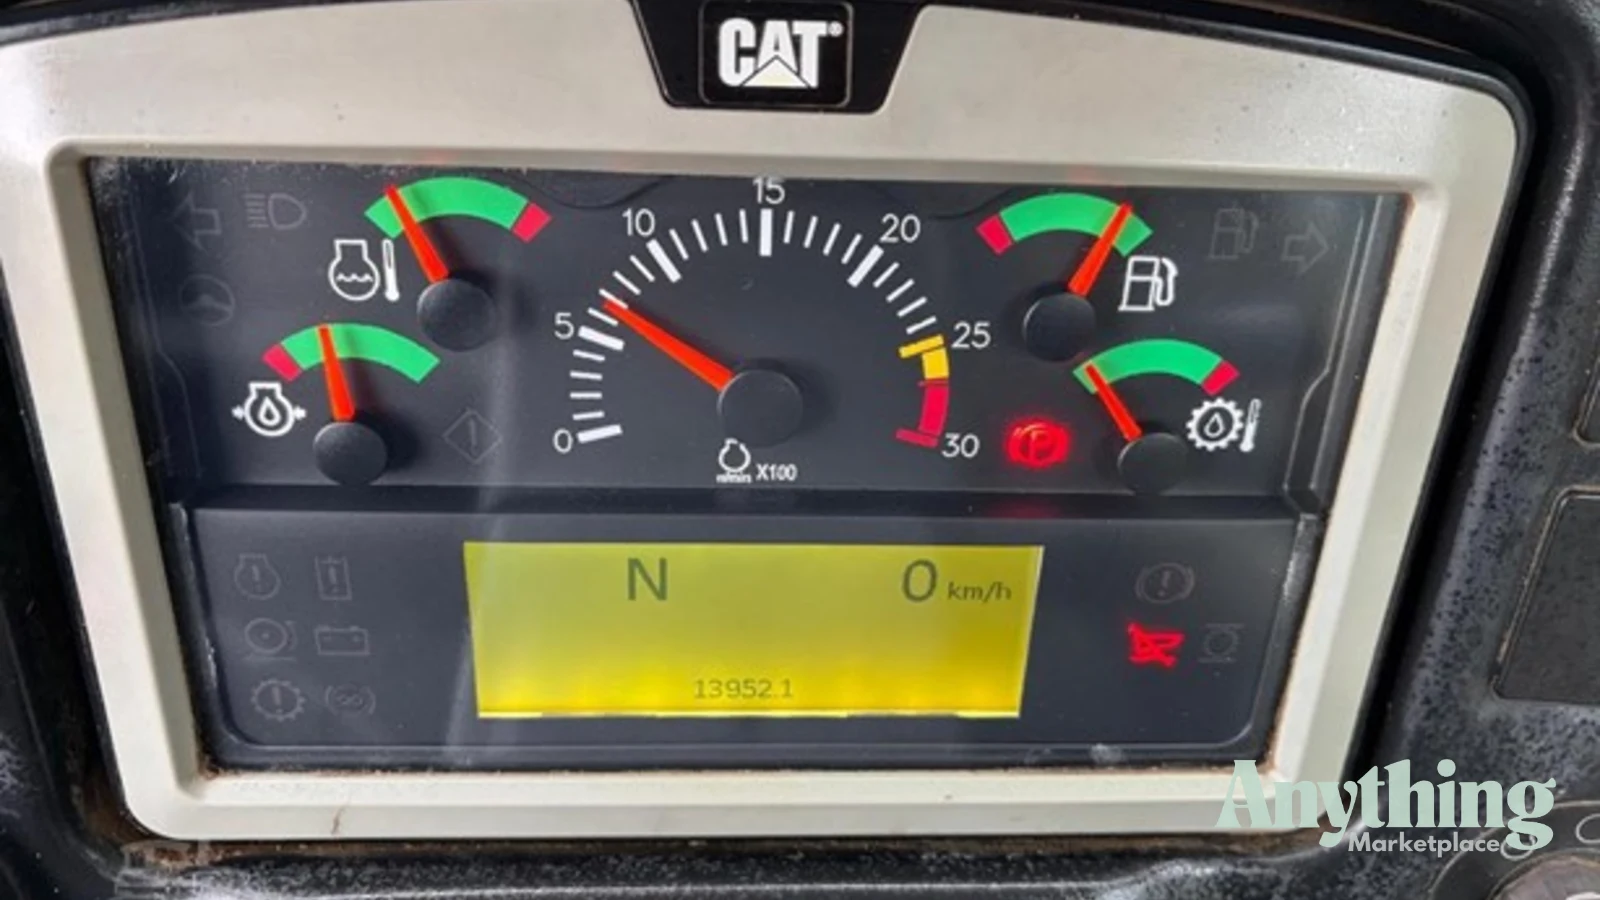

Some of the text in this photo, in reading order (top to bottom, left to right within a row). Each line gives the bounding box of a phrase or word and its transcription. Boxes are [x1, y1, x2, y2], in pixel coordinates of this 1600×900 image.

[753, 176, 786, 205] 15
[622, 208, 656, 237] 10
[880, 212, 921, 244] 20
[553, 312, 576, 340] 5
[951, 321, 992, 350] 25
[552, 428, 575, 455] 0
[940, 431, 980, 460] 30
[755, 463, 798, 482] X100
[626, 557, 669, 602] N
[901, 558, 1013, 604] 0 km/h
[693, 678, 795, 701] 13952.1
